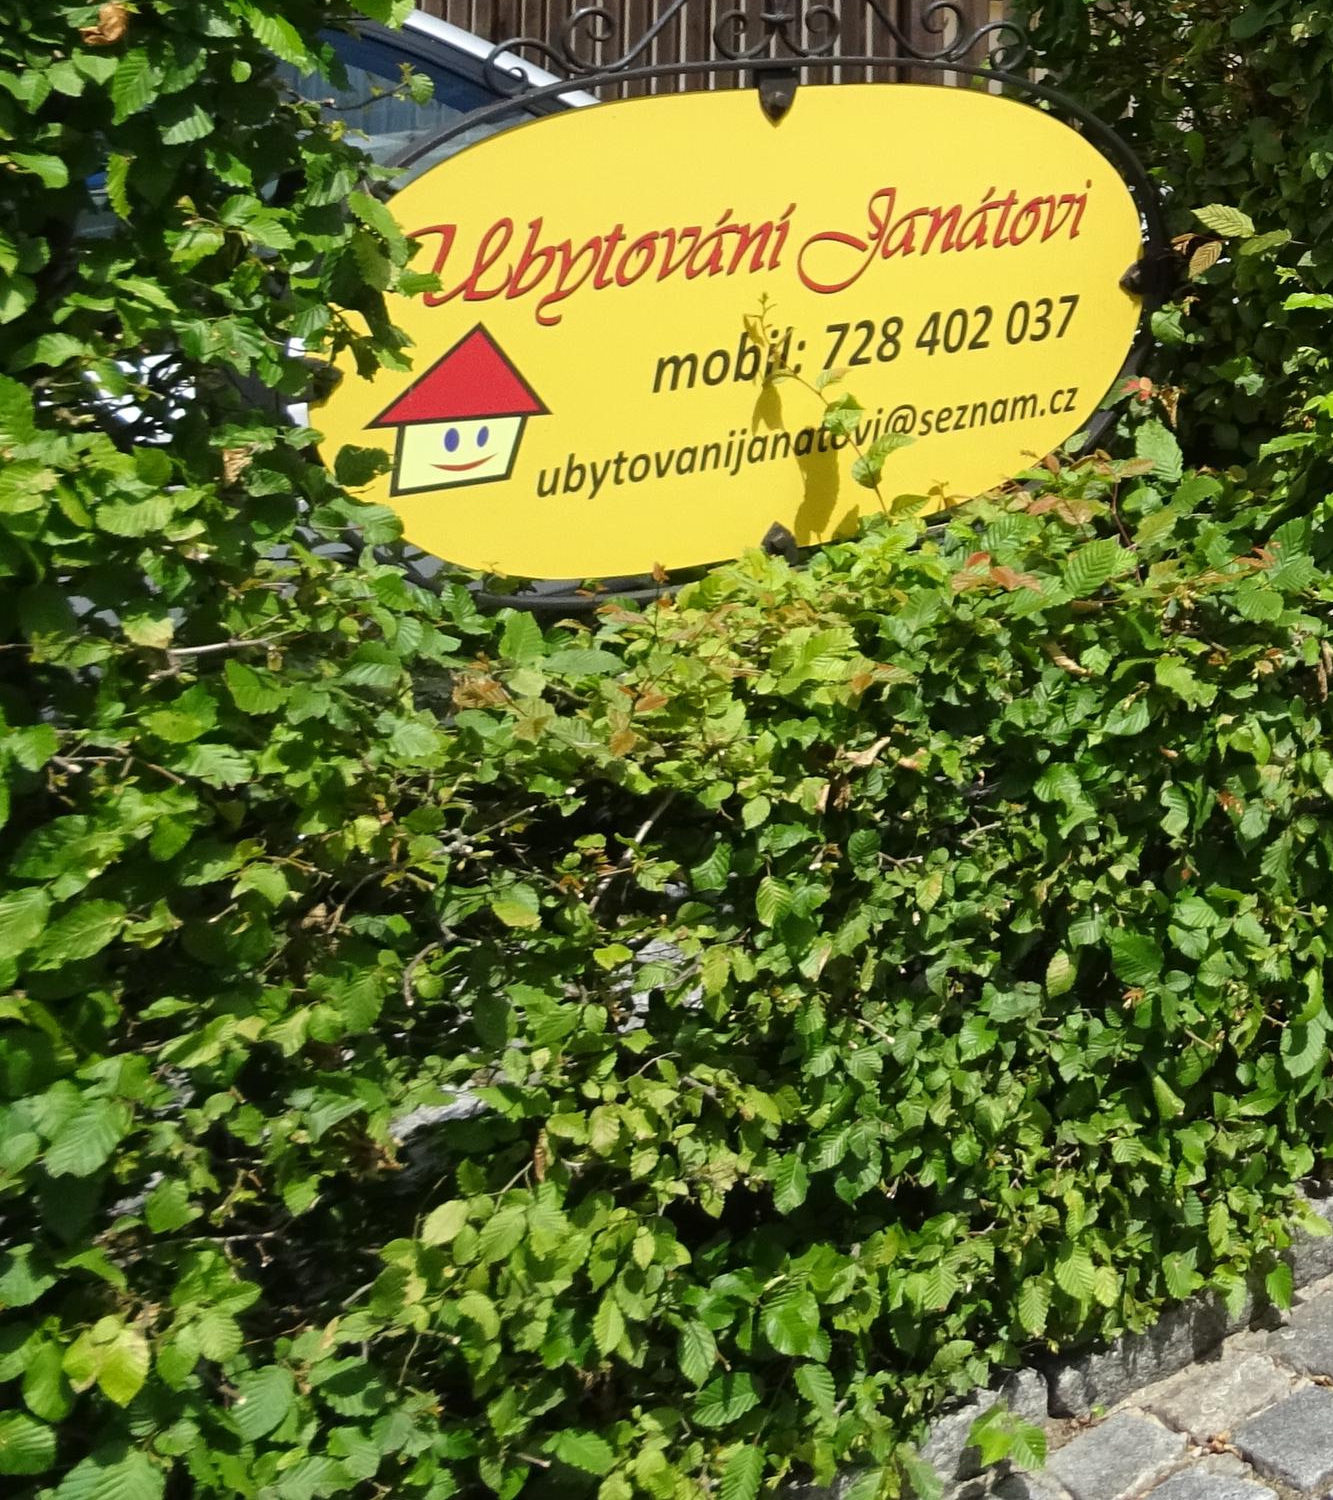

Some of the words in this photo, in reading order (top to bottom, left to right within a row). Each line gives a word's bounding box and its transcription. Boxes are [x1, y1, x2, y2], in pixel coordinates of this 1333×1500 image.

[405, 202, 797, 327] Ubytování
[797, 179, 1093, 295] Janátovi
[822, 316, 904, 370] 728
[916, 304, 993, 366] 402
[1007, 294, 1079, 345] 037
[536, 386, 1079, 501] ubytovanijanatovi@seznam.cz
